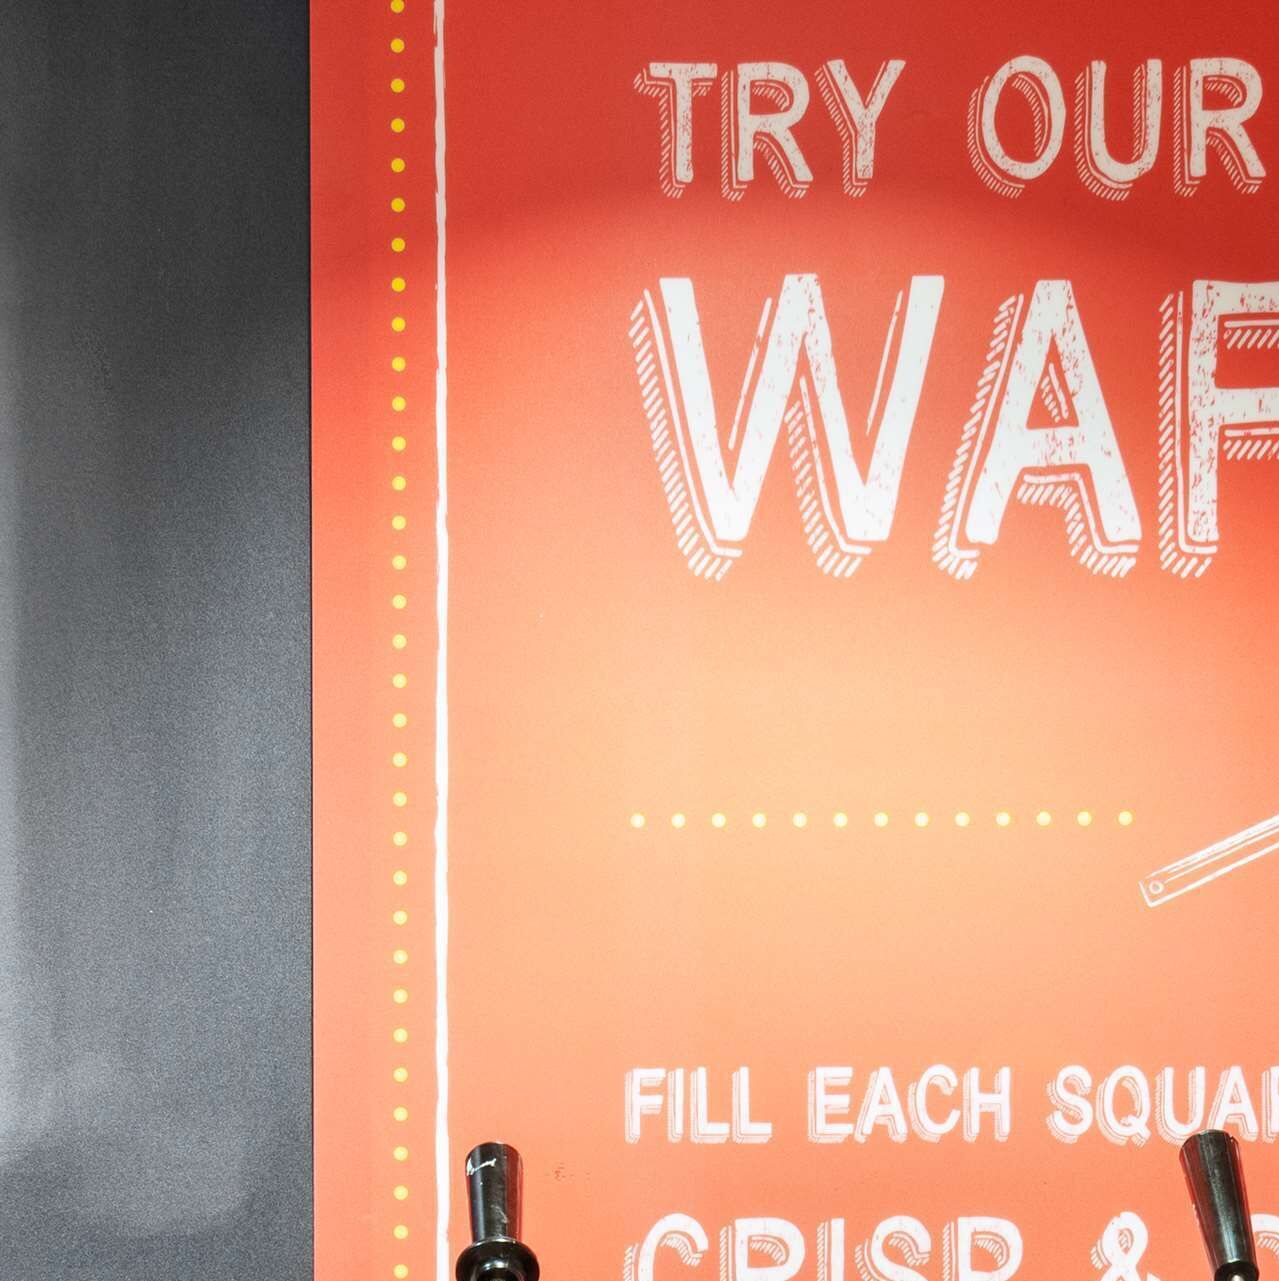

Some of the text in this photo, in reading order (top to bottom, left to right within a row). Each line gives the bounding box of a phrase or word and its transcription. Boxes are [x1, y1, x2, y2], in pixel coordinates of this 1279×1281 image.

[634, 59, 906, 200] TRY
[967, 55, 1265, 200] OUR
[625, 1066, 773, 1143] FILL
[808, 1064, 1012, 1143] EACH
